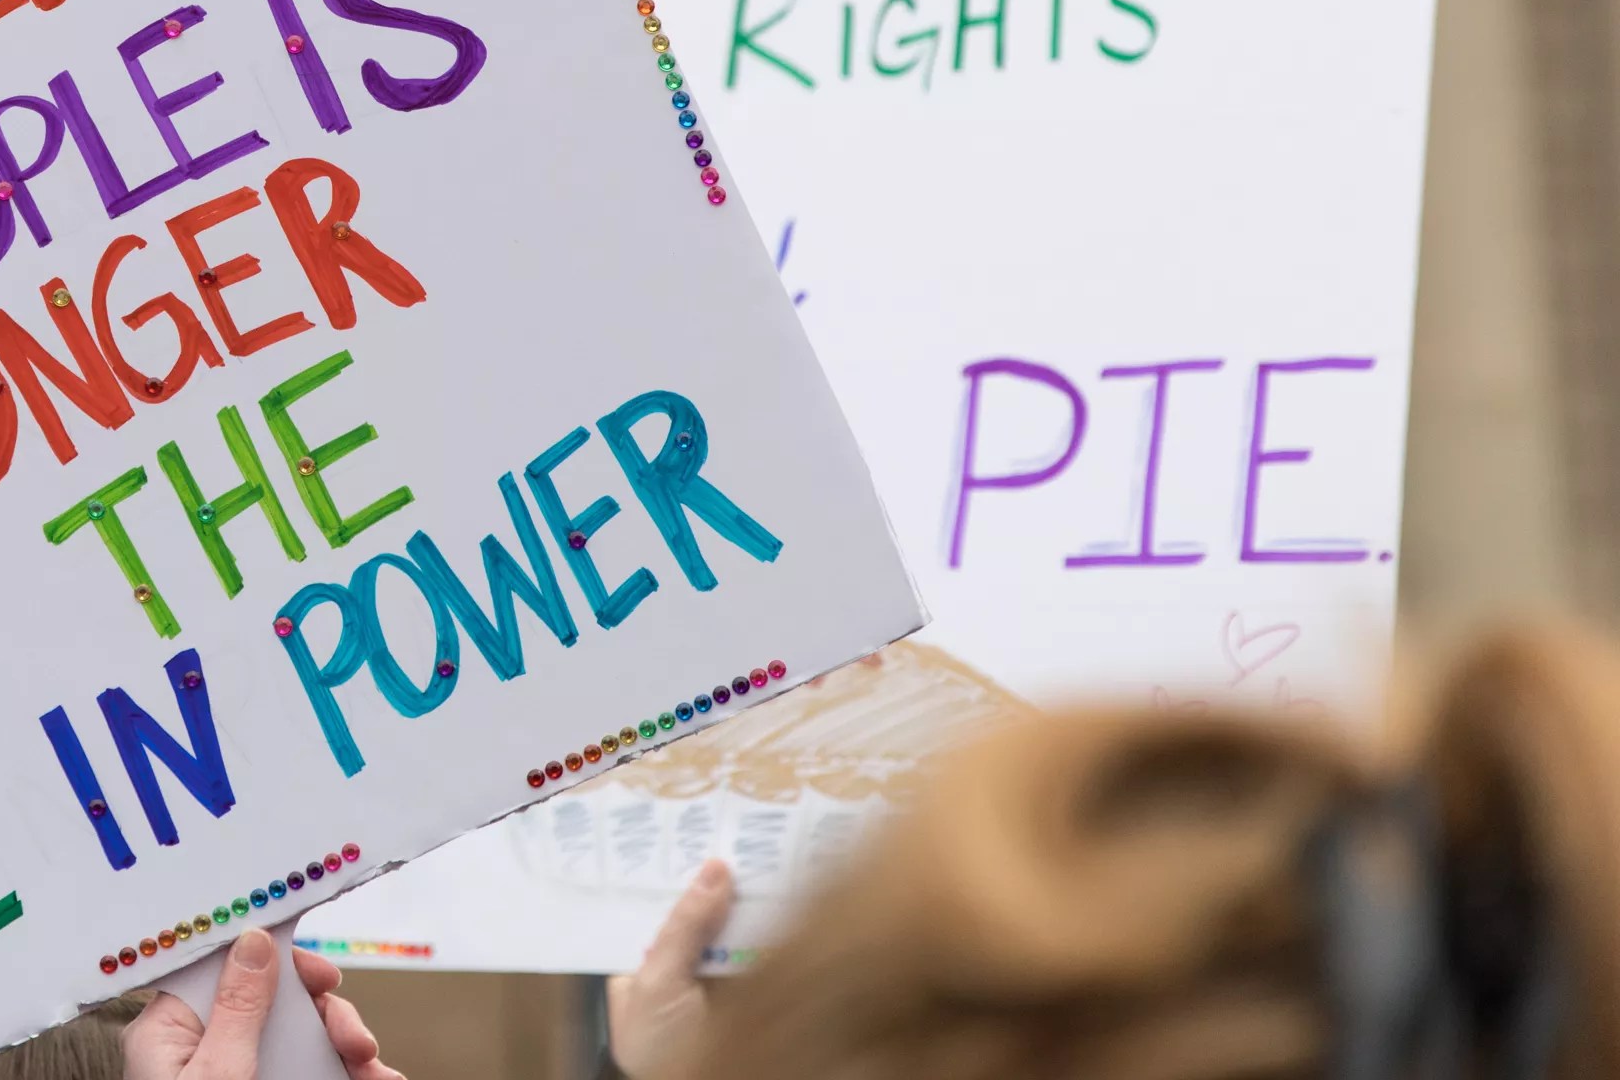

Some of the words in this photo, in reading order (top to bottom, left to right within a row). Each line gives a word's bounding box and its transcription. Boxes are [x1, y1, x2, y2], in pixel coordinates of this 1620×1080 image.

[42, 349, 415, 640] THE
[942, 356, 1394, 570] PIE.
[39, 648, 236, 871] IN
[274, 389, 785, 780] POWER
